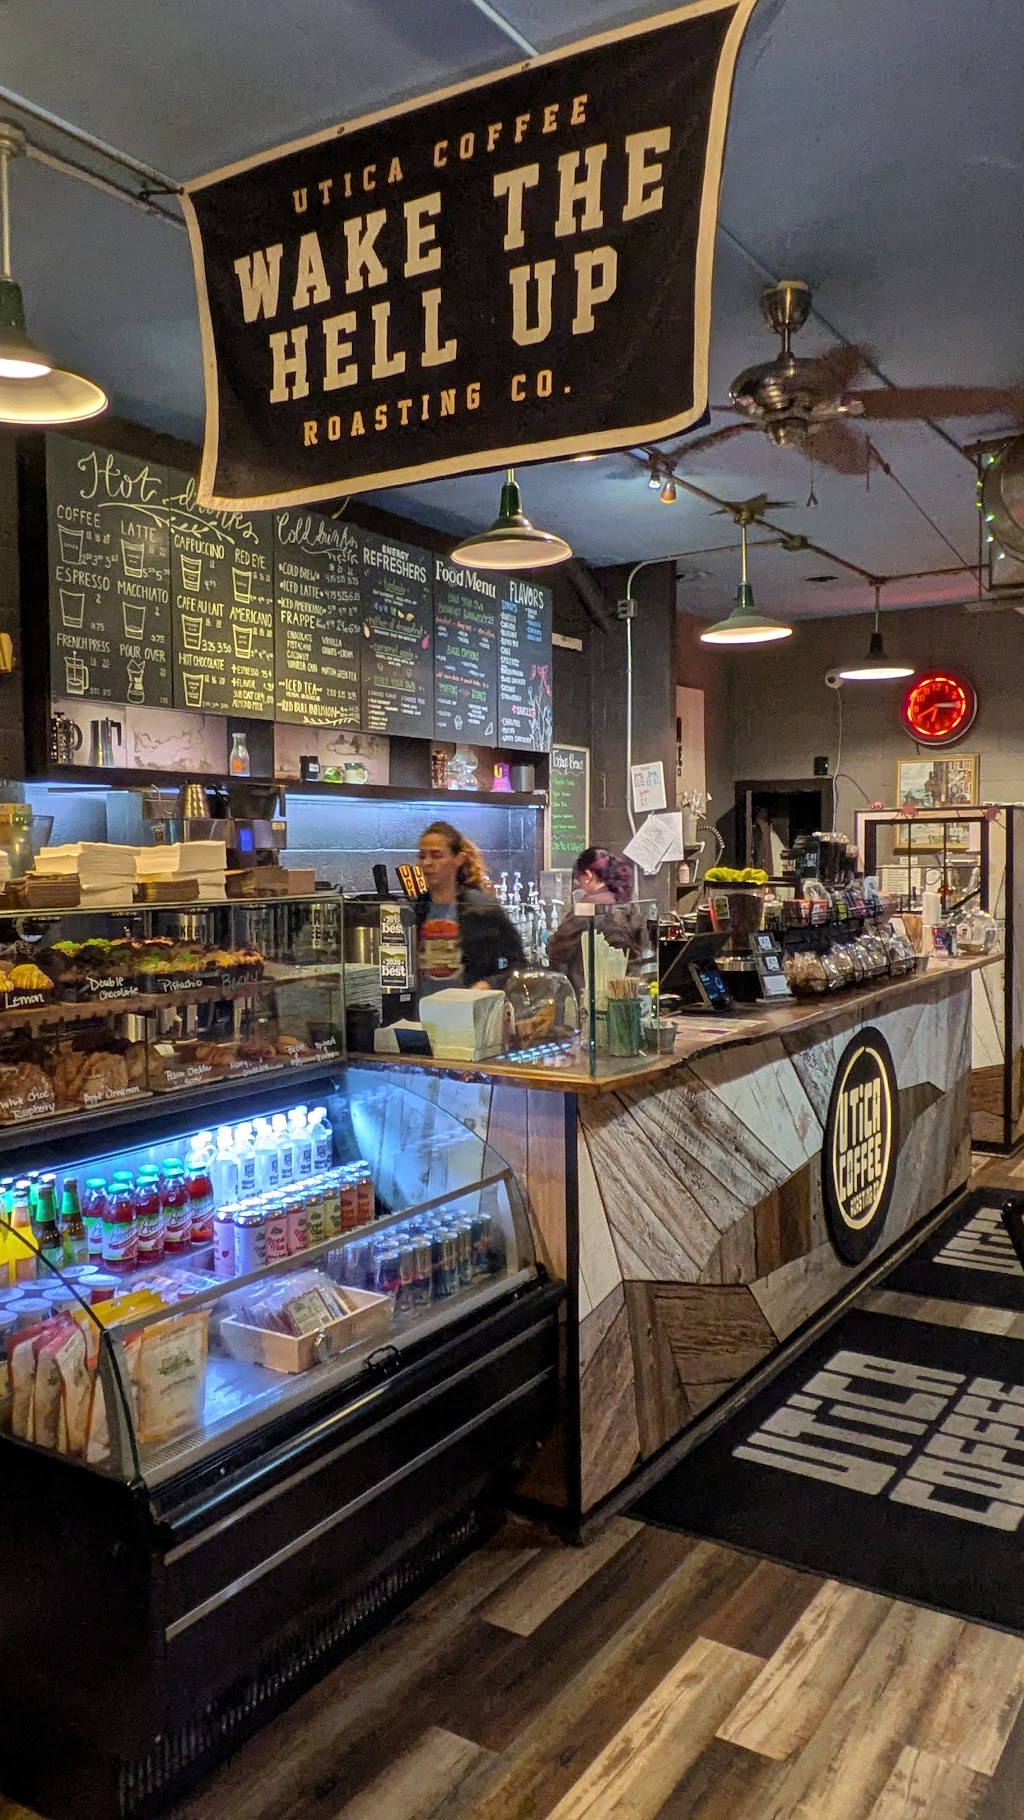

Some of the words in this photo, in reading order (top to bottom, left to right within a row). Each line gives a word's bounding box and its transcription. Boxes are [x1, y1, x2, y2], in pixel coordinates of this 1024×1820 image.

[292, 156, 403, 213] UTICA
[434, 94, 588, 168] COFFEE
[234, 192, 443, 324] WAKE
[493, 126, 672, 252] THE
[268, 289, 458, 404] HELL
[509, 245, 619, 347] UP
[303, 382, 481, 448] ROASTING
[511, 369, 573, 402] CO.
[78, 451, 162, 502] Hot
[56, 504, 101, 528] COFFEE
[121, 520, 157, 543] LATTE
[276, 512, 315, 546] Cold
[174, 534, 225, 560] CAPPUCCINO
[382, 544, 409, 561] ENERGY
[235, 548, 250, 565] RED
[251, 553, 266, 569] EYE
[363, 547, 427, 584] REFRESHERS
[56, 565, 111, 591] ESPRESSO
[282, 562, 298, 577] COLD
[435, 560, 464, 587] Food
[465, 569, 497, 599] Menu
[117, 580, 169, 604] MACCHIATO
[283, 580, 298, 594] ICED
[300, 584, 320, 599] LATTE
[509, 580, 544, 610] FLAVORS
[177, 595, 196, 612] CAFE
[197, 600, 207, 614] AU
[208, 602, 224, 617] LAIT
[229, 606, 273, 627] AMERICANO
[280, 610, 315, 629] FRAPPE
[57, 633, 87, 650] FRENCH
[88, 638, 110, 653] PRESS
[120, 644, 141, 659] POUR
[144, 647, 166, 662] OVER
[178, 652, 193, 666] HOT
[193, 655, 225, 671] CHOCOLATE
[285, 679, 303, 693] ICED
[932, 683, 941, 691] 12
[951, 691, 957, 699] 2
[913, 705, 919, 713] 9
[917, 695, 925, 703] 10
[381, 922, 405, 934] best
[381, 966, 406, 977] best
[86, 976, 124, 991] Double
[99, 986, 139, 1000] Chocolate
[157, 978, 202, 993] Pistachio
[5, 992, 44, 1009] Lemon
[838, 1132, 882, 1204] COFFEE
